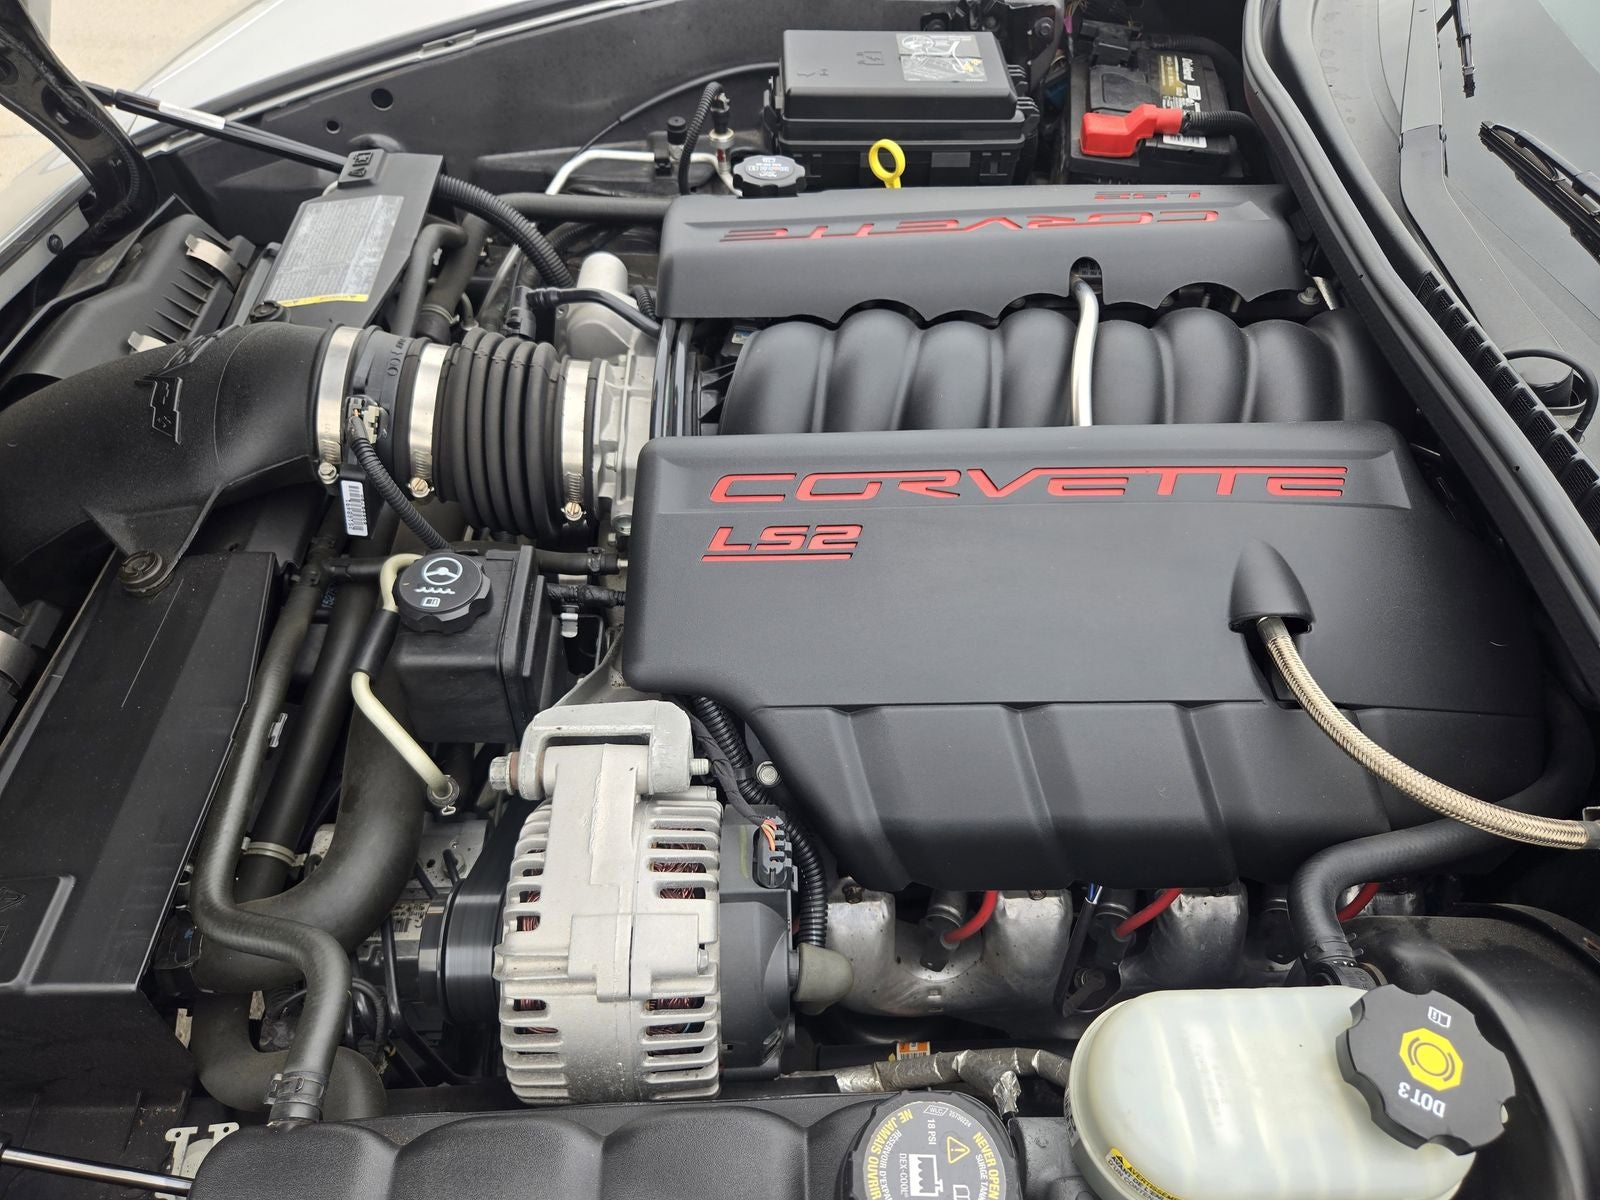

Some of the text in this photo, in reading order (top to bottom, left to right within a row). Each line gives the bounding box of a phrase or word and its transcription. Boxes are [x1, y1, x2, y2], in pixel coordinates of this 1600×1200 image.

[719, 210, 1220, 243] CORVETTE
[709, 466, 1347, 503] CORVETTE
[702, 524, 864, 561] LS2
[1398, 1081, 1446, 1119] DOT 3
[879, 1129, 902, 1169] RESERVOIR
[927, 1119, 937, 1145] 18 PSI
[866, 1108, 914, 1200] NE JAMAIS OUVRIR
[972, 1131, 1001, 1200] NEVER OPEN
[975, 1153, 989, 1180] SURGE
